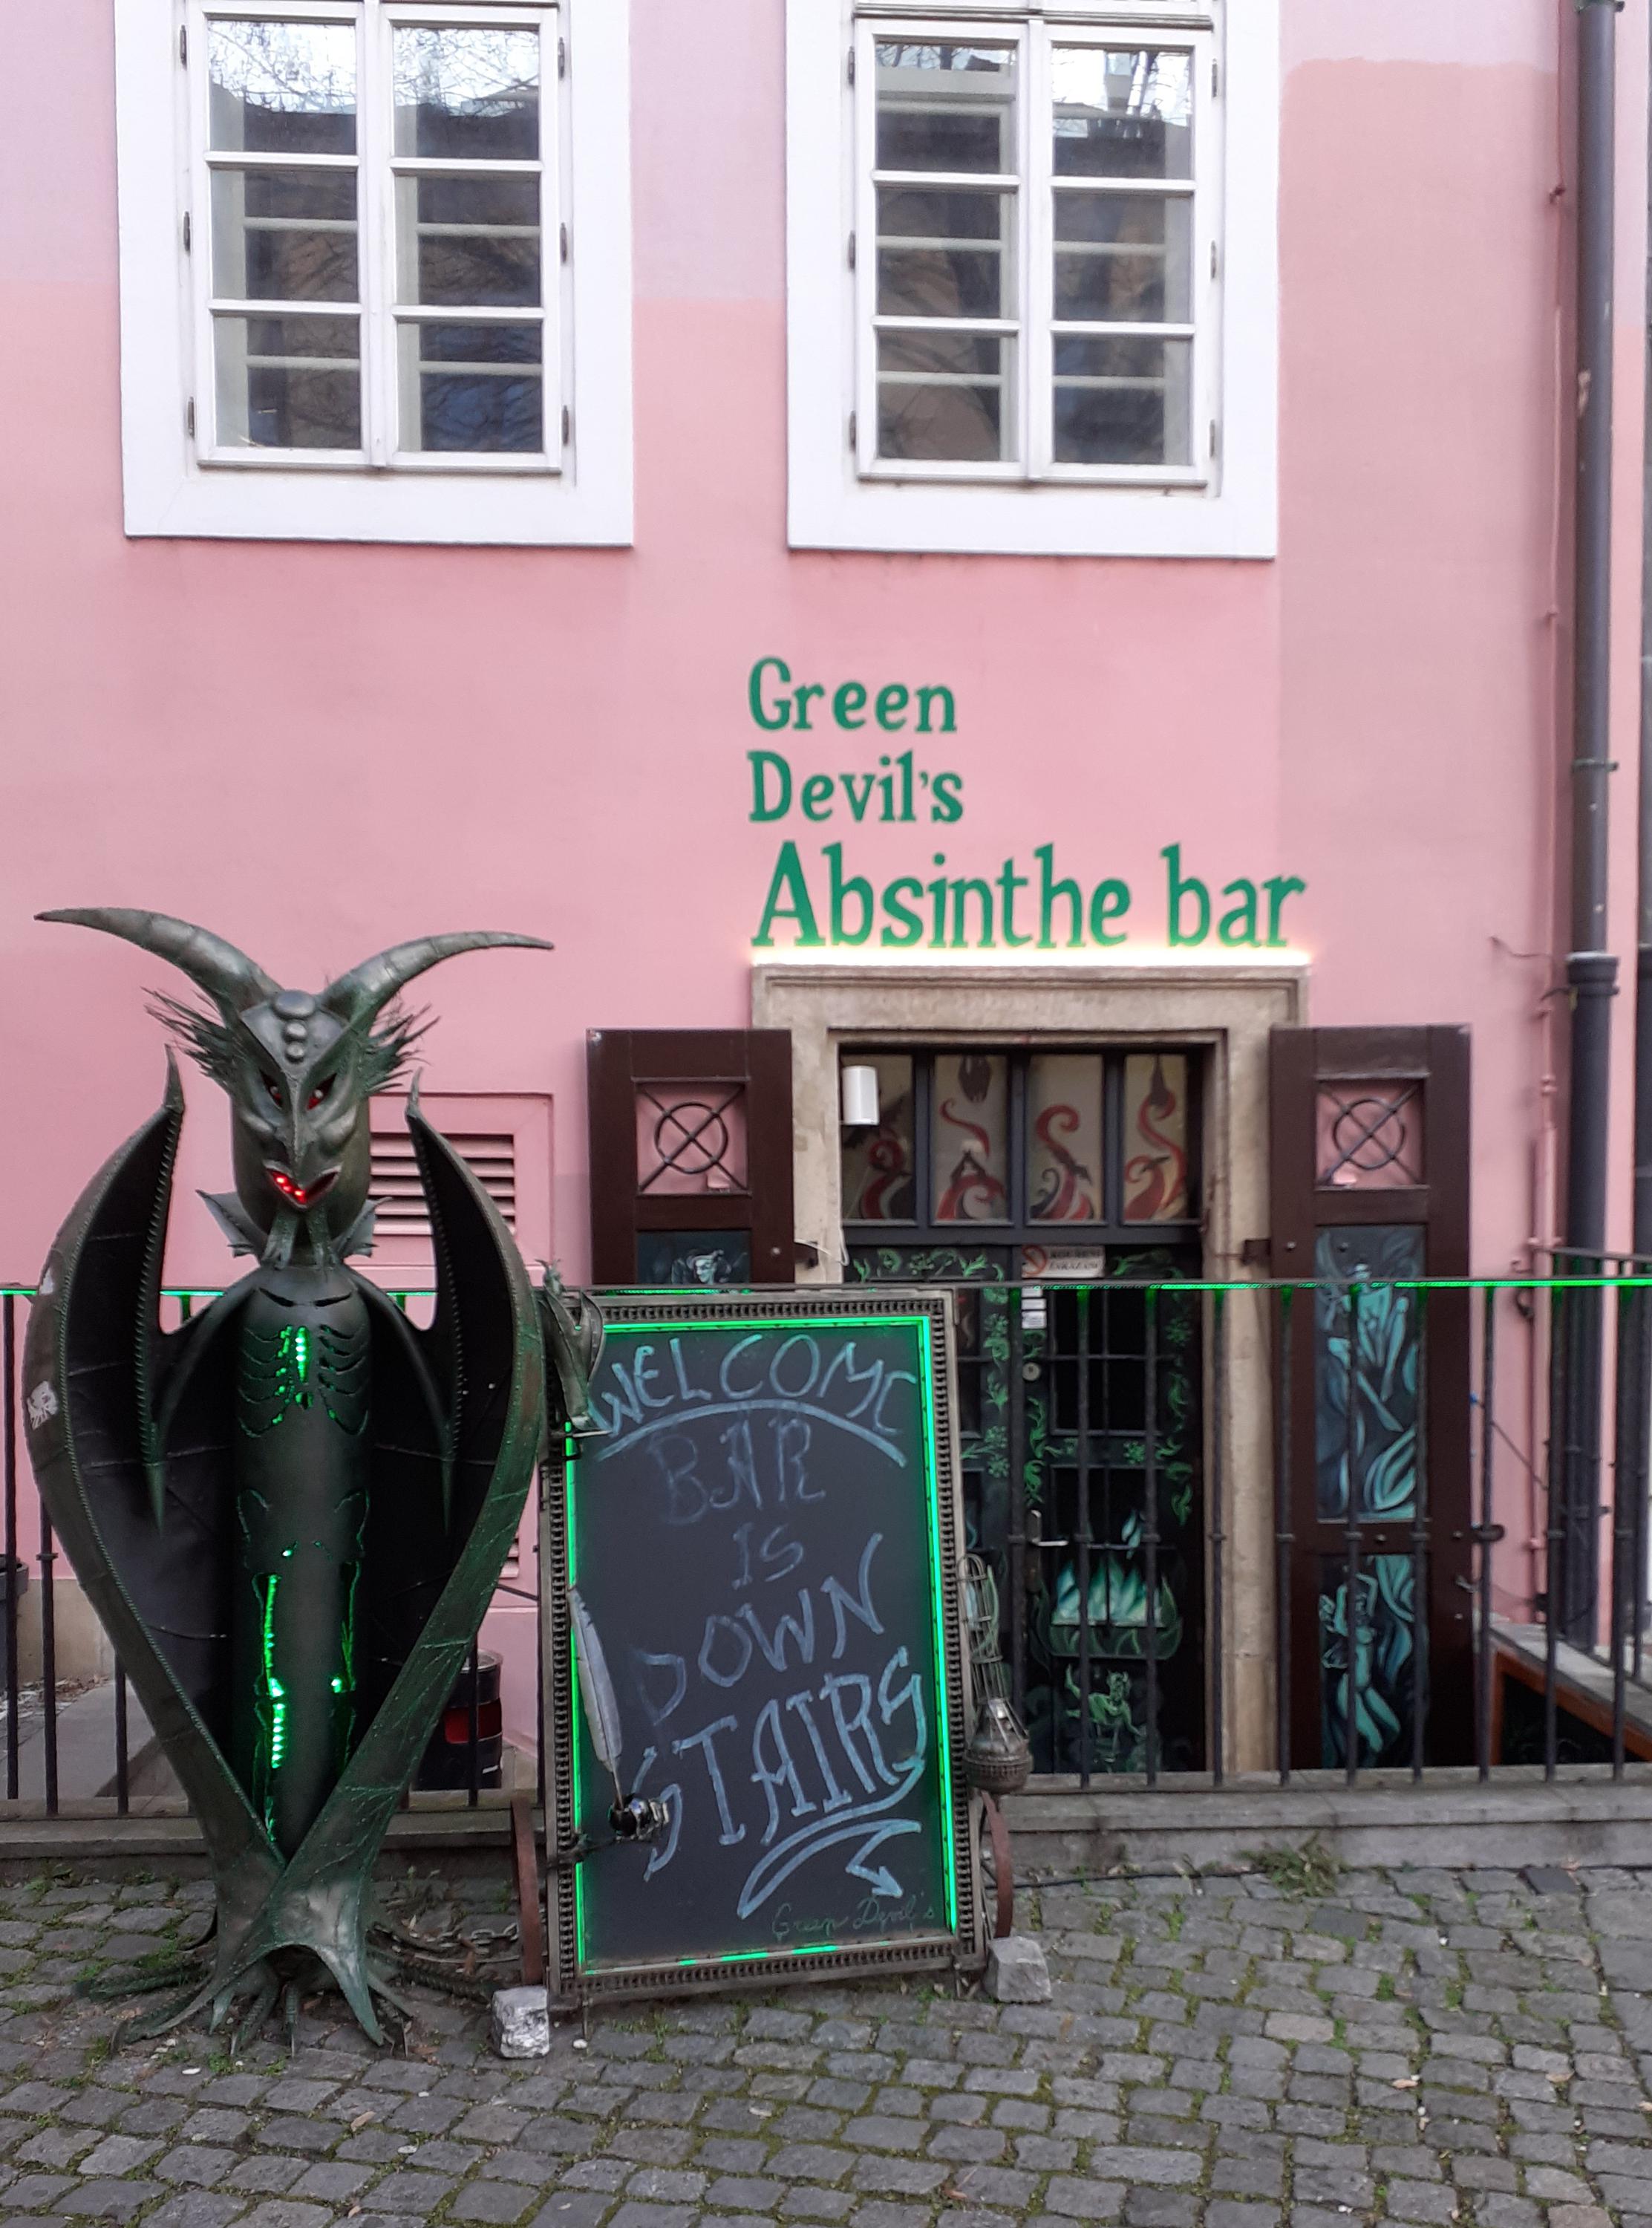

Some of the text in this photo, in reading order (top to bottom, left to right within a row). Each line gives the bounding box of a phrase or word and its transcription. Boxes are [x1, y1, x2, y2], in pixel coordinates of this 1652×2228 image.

[748, 656, 957, 733] Green
[747, 749, 964, 823] Devil's
[751, 840, 1307, 948] Absinthe bar
[648, 1418, 826, 1525] BAR
[732, 1522, 804, 1589] IS
[631, 1531, 885, 1727] DOWN
[627, 1644, 927, 1883] STAIRS
